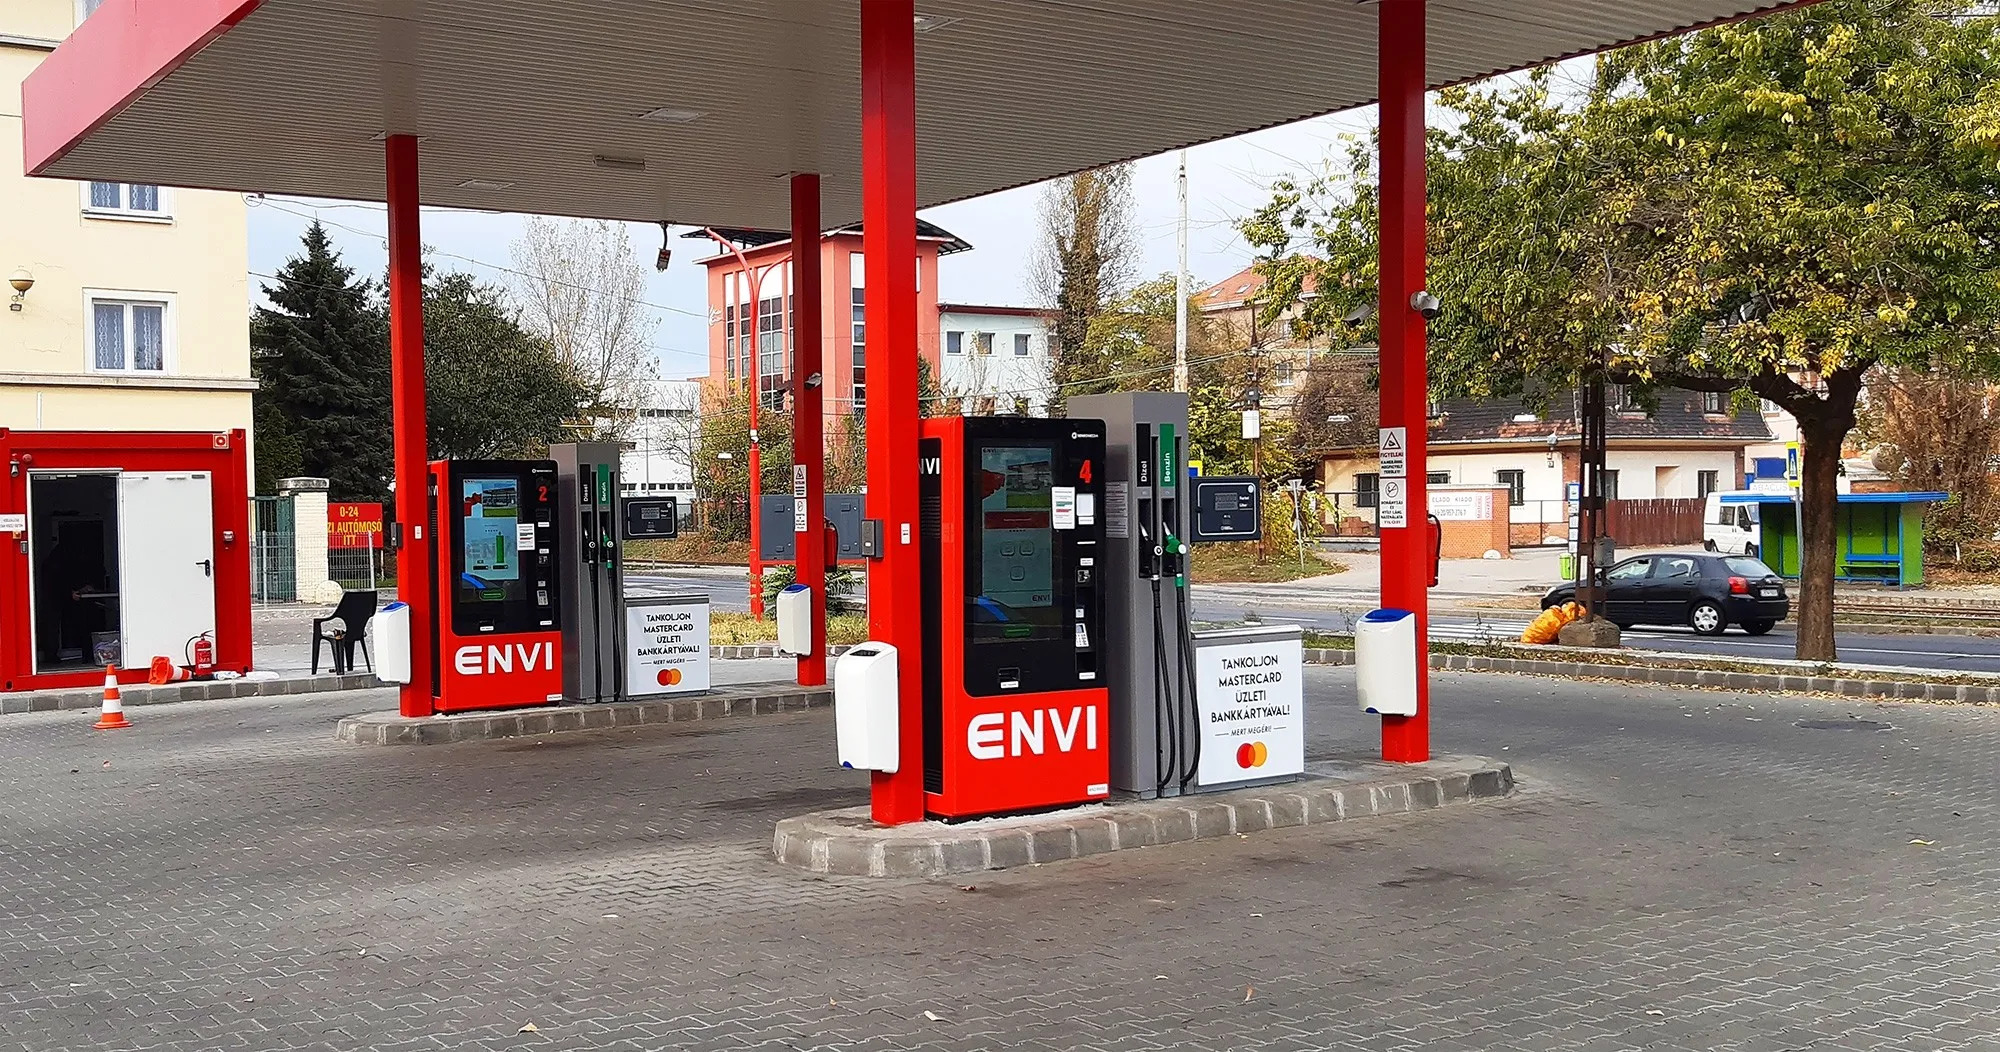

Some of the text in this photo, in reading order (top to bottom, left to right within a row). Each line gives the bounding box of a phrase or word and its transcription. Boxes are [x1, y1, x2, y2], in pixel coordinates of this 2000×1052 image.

[918, 457, 940, 475] NVI
[1079, 459, 1092, 484] 4
[1163, 452, 1171, 482] Benzin
[538, 485, 548, 502] 2
[339, 506, 359, 517] 0-24
[343, 534, 357, 546] ITT
[1032, 594, 1051, 602] ENVI
[646, 612, 691, 622] TANKOLJON
[643, 623, 694, 634] MASTERCARD
[656, 634, 682, 644] ÜZLETI
[455, 641, 553, 675] ENVI
[637, 644, 700, 657] BANKKÁRTYÁVAL!
[1221, 654, 1279, 670] TANKOLJON
[1218, 671, 1283, 688] MASTERCARD
[1235, 689, 1267, 703] ÜZLETI
[1211, 702, 1290, 723] BANKKÁRTYÁVAL!
[967, 704, 1097, 760] ENVI
[1230, 728, 1247, 737] MERT
